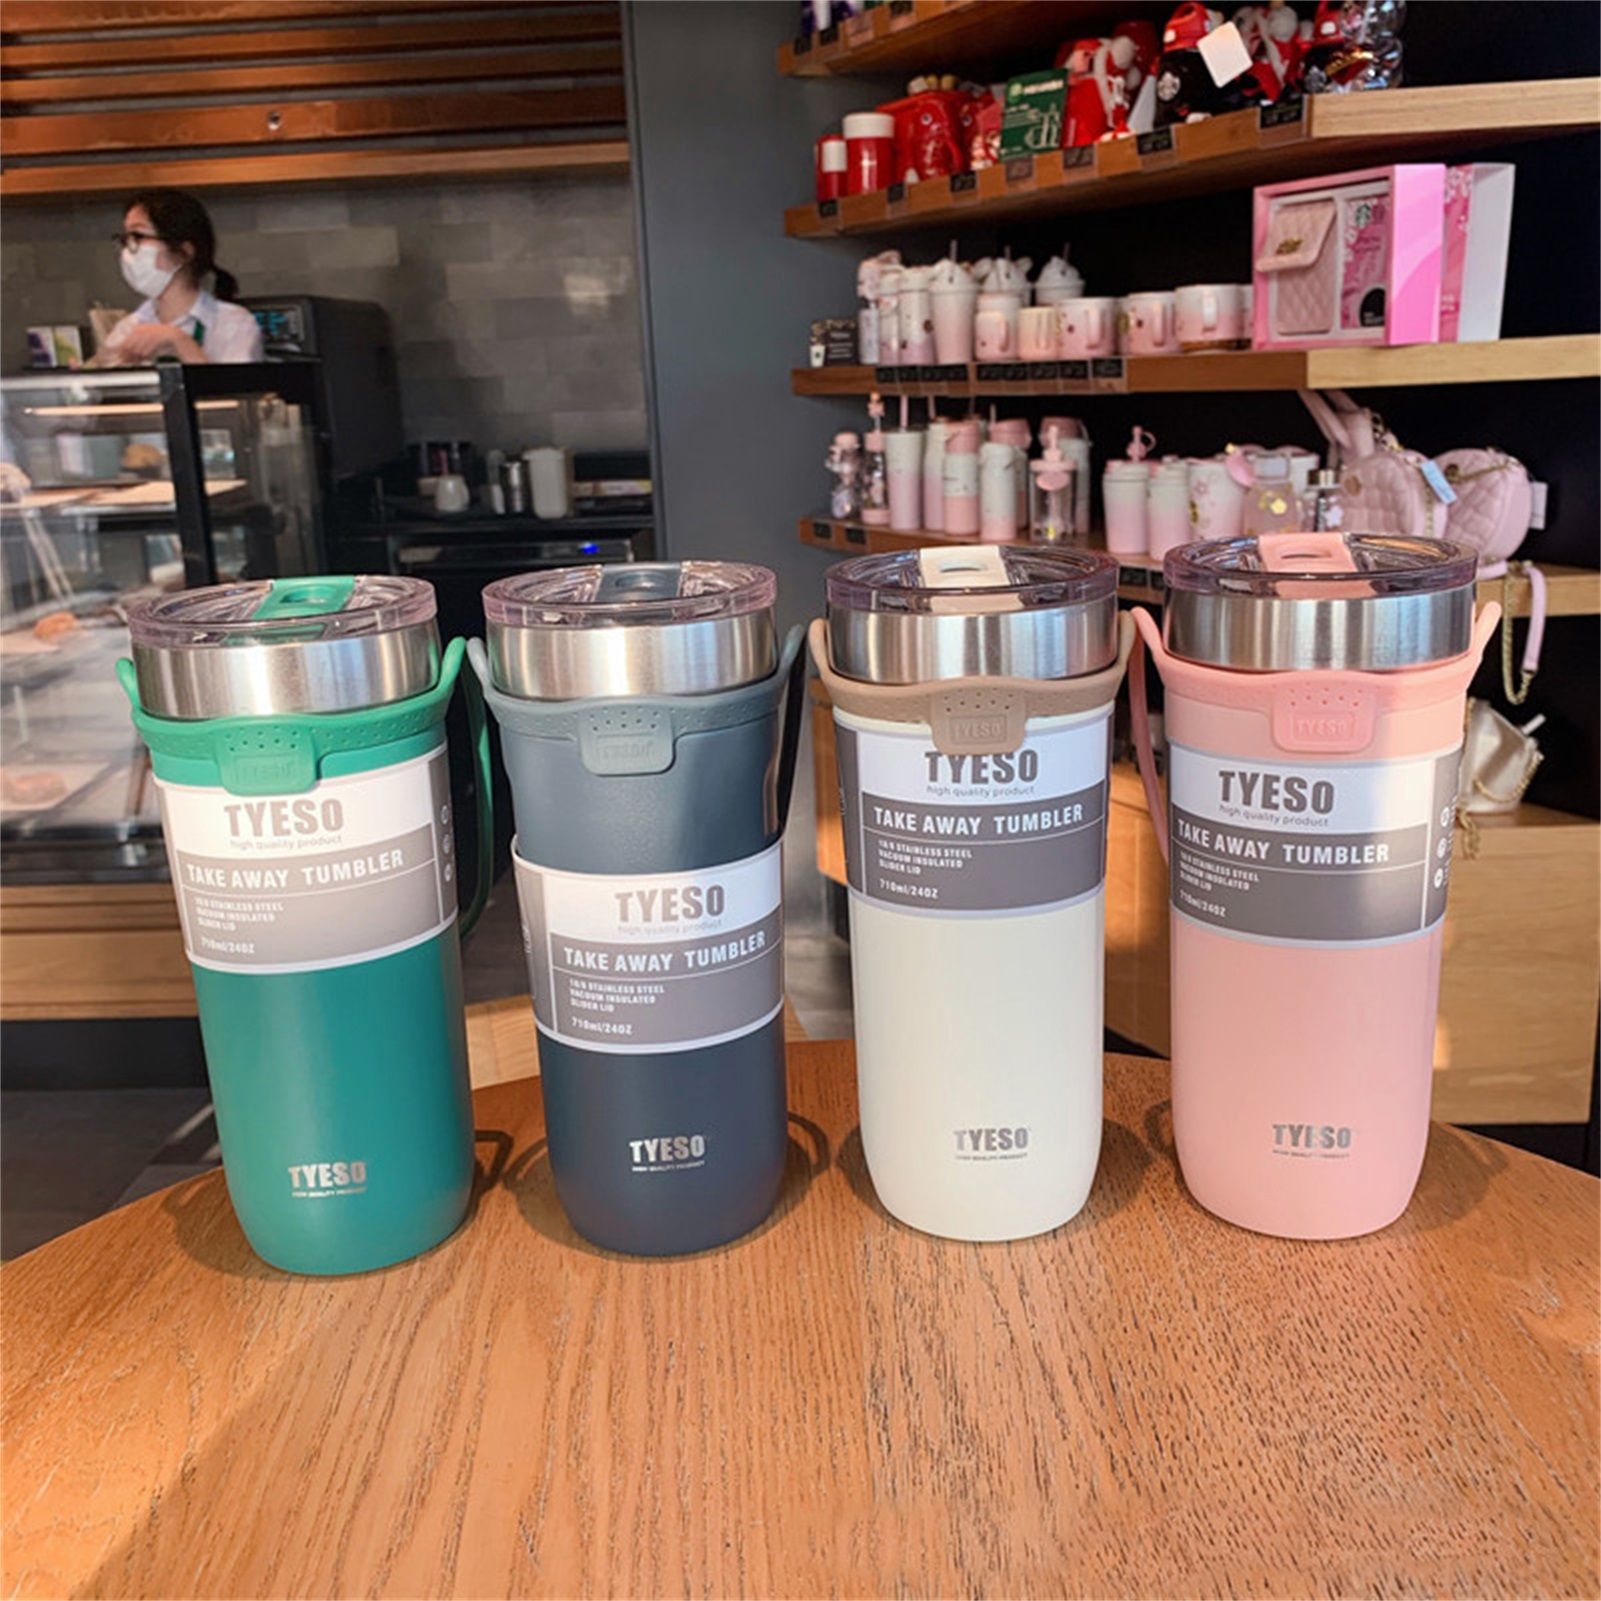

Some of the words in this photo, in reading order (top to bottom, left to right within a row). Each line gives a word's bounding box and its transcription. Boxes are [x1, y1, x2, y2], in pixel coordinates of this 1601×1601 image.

[925, 750, 1038, 784] TYESO
[927, 786, 950, 797] high
[952, 786, 991, 798] quality
[993, 786, 1034, 797] product
[1219, 770, 1334, 815] TYESO
[224, 798, 344, 838] TYESO
[873, 807, 917, 831] TAKE
[922, 816, 982, 835] AWAY
[994, 803, 1083, 834] TUMBLER
[1283, 816, 1329, 827] product
[1178, 819, 1210, 847] TAKE
[1214, 835, 1271, 860] AWAY
[1283, 844, 1389, 865] TUMBLER
[186, 864, 226, 887] TAKE
[231, 869, 289, 888] AWAY
[301, 849, 404, 886] TUMBLER
[614, 884, 725, 922] TYESO
[564, 947, 609, 971] TAKE
[615, 953, 672, 972] AWAY
[684, 930, 765, 969] TUMBLER
[629, 1135, 705, 1163] TYESO
[953, 1127, 1029, 1151] TYESO
[288, 1162, 366, 1188] TYESO
